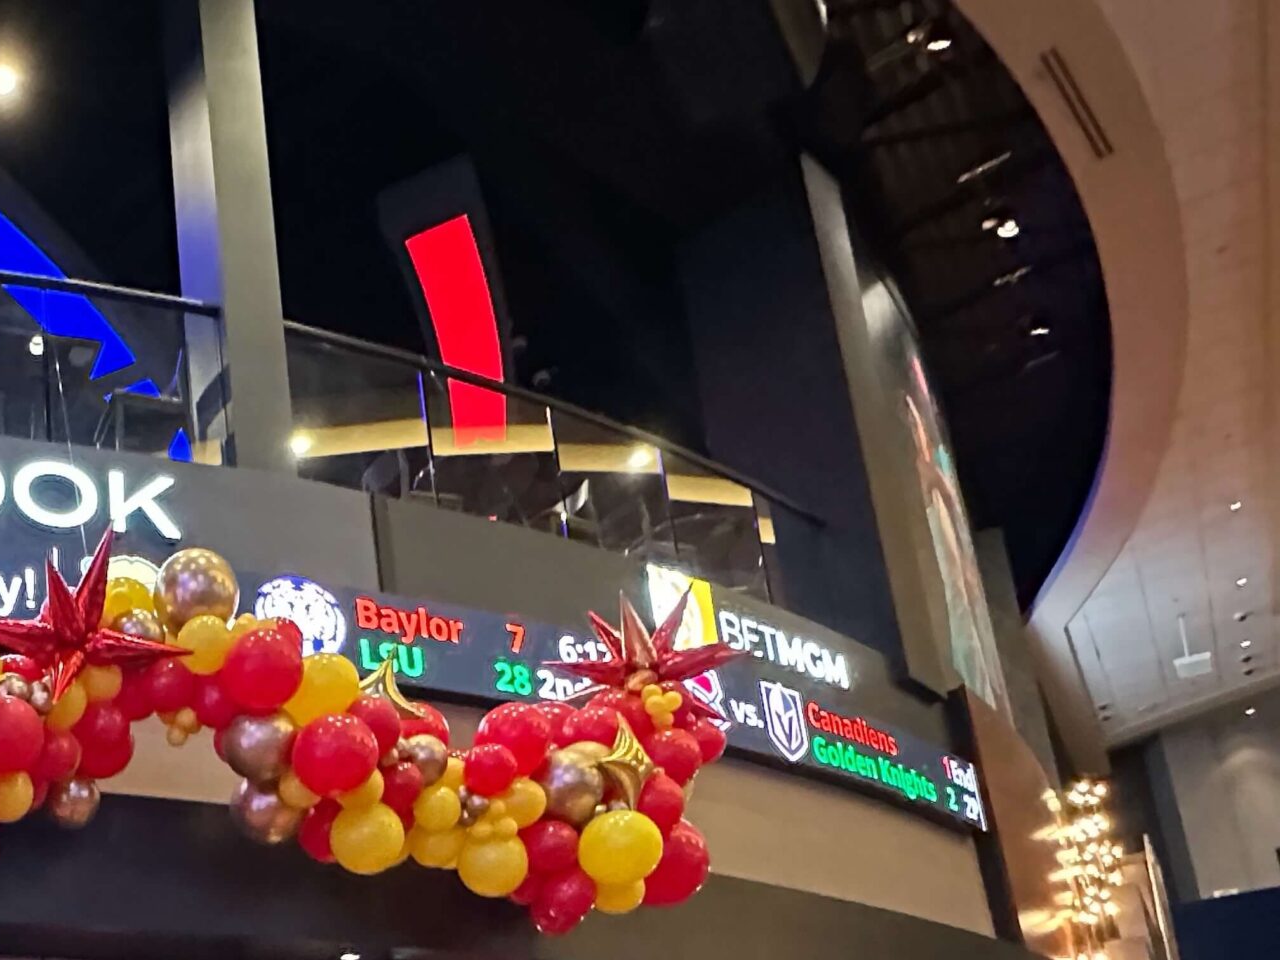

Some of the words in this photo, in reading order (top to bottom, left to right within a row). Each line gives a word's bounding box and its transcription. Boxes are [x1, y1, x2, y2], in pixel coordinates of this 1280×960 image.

[354, 596, 464, 645] Baylor
[505, 623, 525, 654] 7
[718, 609, 850, 690] BETMGM
[359, 637, 424, 679] LSU
[493, 659, 533, 697] 28
[729, 698, 765, 729] vs.
[807, 701, 899, 757] Canadiens
[811, 735, 879, 780] Golden
[880, 756, 938, 803] Knights
[945, 786, 960, 812] 2
